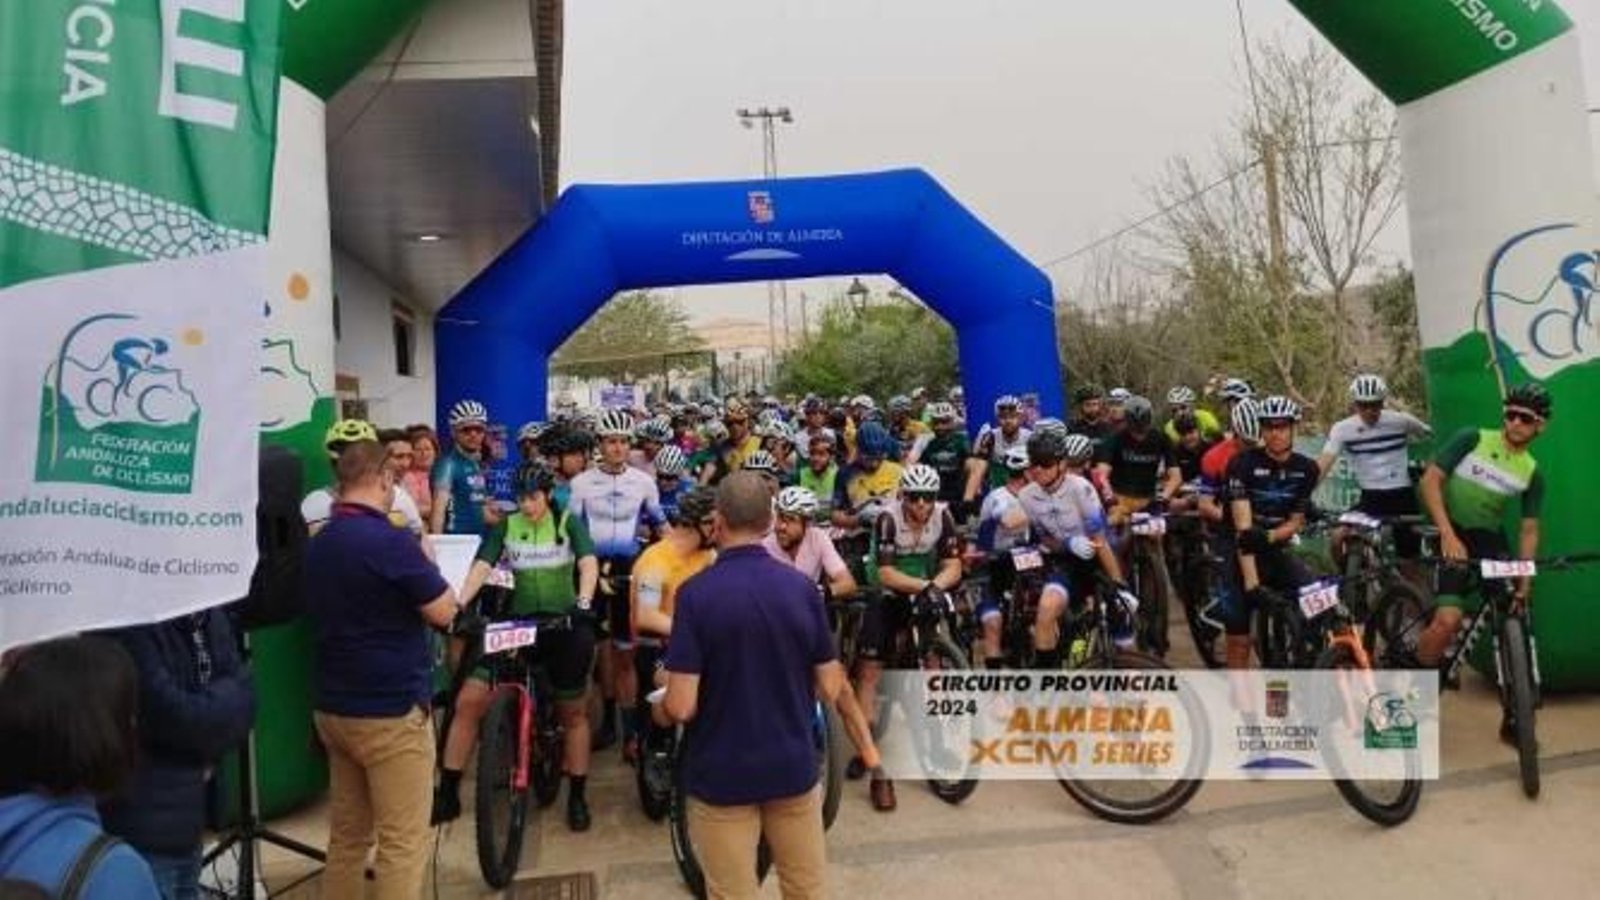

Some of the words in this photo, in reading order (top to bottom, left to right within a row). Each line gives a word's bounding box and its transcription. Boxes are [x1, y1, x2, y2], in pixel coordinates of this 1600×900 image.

[61, 0, 116, 106] CIA
[767, 231, 783, 243] DE
[91, 464, 114, 479] DE
[0, 547, 58, 566] ración
[138, 559, 161, 576] de
[164, 557, 240, 576] Ciclismo
